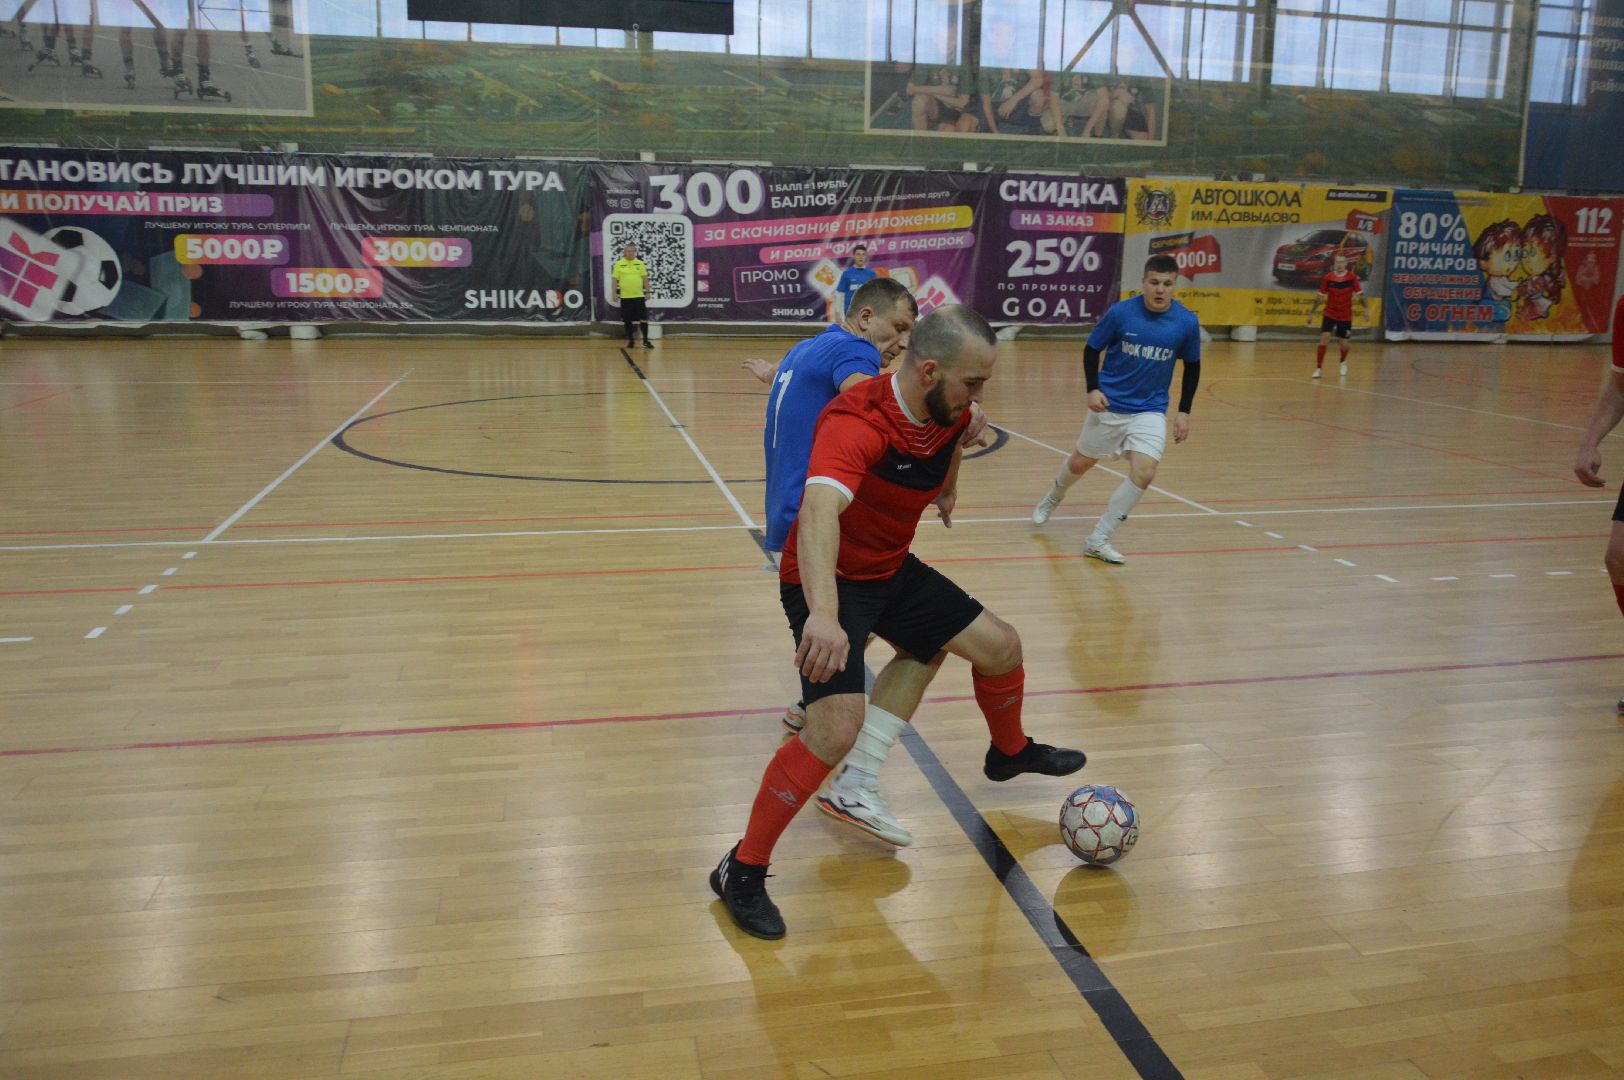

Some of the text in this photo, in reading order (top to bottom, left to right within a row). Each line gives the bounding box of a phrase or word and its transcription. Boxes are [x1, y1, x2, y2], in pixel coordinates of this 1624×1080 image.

[0, 159, 566, 192] ТАНОВИСЬ ЛУЧШИМ ИГРОКОМ ТУРА
[649, 169, 763, 217] 300
[769, 184, 774, 192] 1
[775, 183, 803, 192] БАЛЛ
[811, 182, 816, 190] 1
[816, 180, 849, 190] РУБЛЬ
[927, 190, 951, 200] друга
[999, 179, 1119, 208] СКИДКА
[2, 190, 224, 213] И ПОЛУЧАЙ ПРИЗ
[771, 193, 837, 209] БАЛЛОВ
[1190, 187, 1303, 208] АВТОШКОЛА
[144, 221, 192, 230] ЛУЧШЕМУ
[193, 222, 229, 231] ИГРОКУ
[231, 223, 253, 231] ТУРА
[377, 224, 411, 232] ИГРОКУ
[413, 224, 435, 233] ТУРА
[439, 225, 499, 233] ЧЕМПИОНАТА
[704, 211, 957, 241] за скачивание приложения
[1020, 213, 1095, 227] НА ЗАКАЗ
[1398, 211, 1467, 242] 80%
[1576, 207, 1613, 234] 112
[186, 238, 284, 259] 5000₽
[373, 240, 463, 262] 3000₽
[769, 249, 780, 260] и
[783, 247, 822, 261] ролл
[888, 240, 897, 251] в
[900, 234, 965, 250] подарок
[1005, 235, 1101, 278] 25%
[1394, 241, 1466, 256] ПРИЧИН
[1168, 251, 1206, 269] 000
[1393, 256, 1478, 271] ПОЖАРОВ
[286, 272, 370, 294] 1500₽
[740, 268, 800, 284] ПРОМО
[771, 283, 801, 295] 1111
[997, 282, 1104, 293] ПО ПРОМОКОДУ
[1403, 286, 1484, 300] ОБРАЩЕНИЕ
[229, 301, 275, 309] ЛУЧШЕМУ
[276, 301, 311, 309] ИГРОКУ
[313, 301, 335, 309] ТУРА
[336, 301, 399, 310] ЧЕМПИОНАТА
[1002, 297, 1092, 318] GOAL
[1407, 303, 1494, 322] С ОГНЕМ
